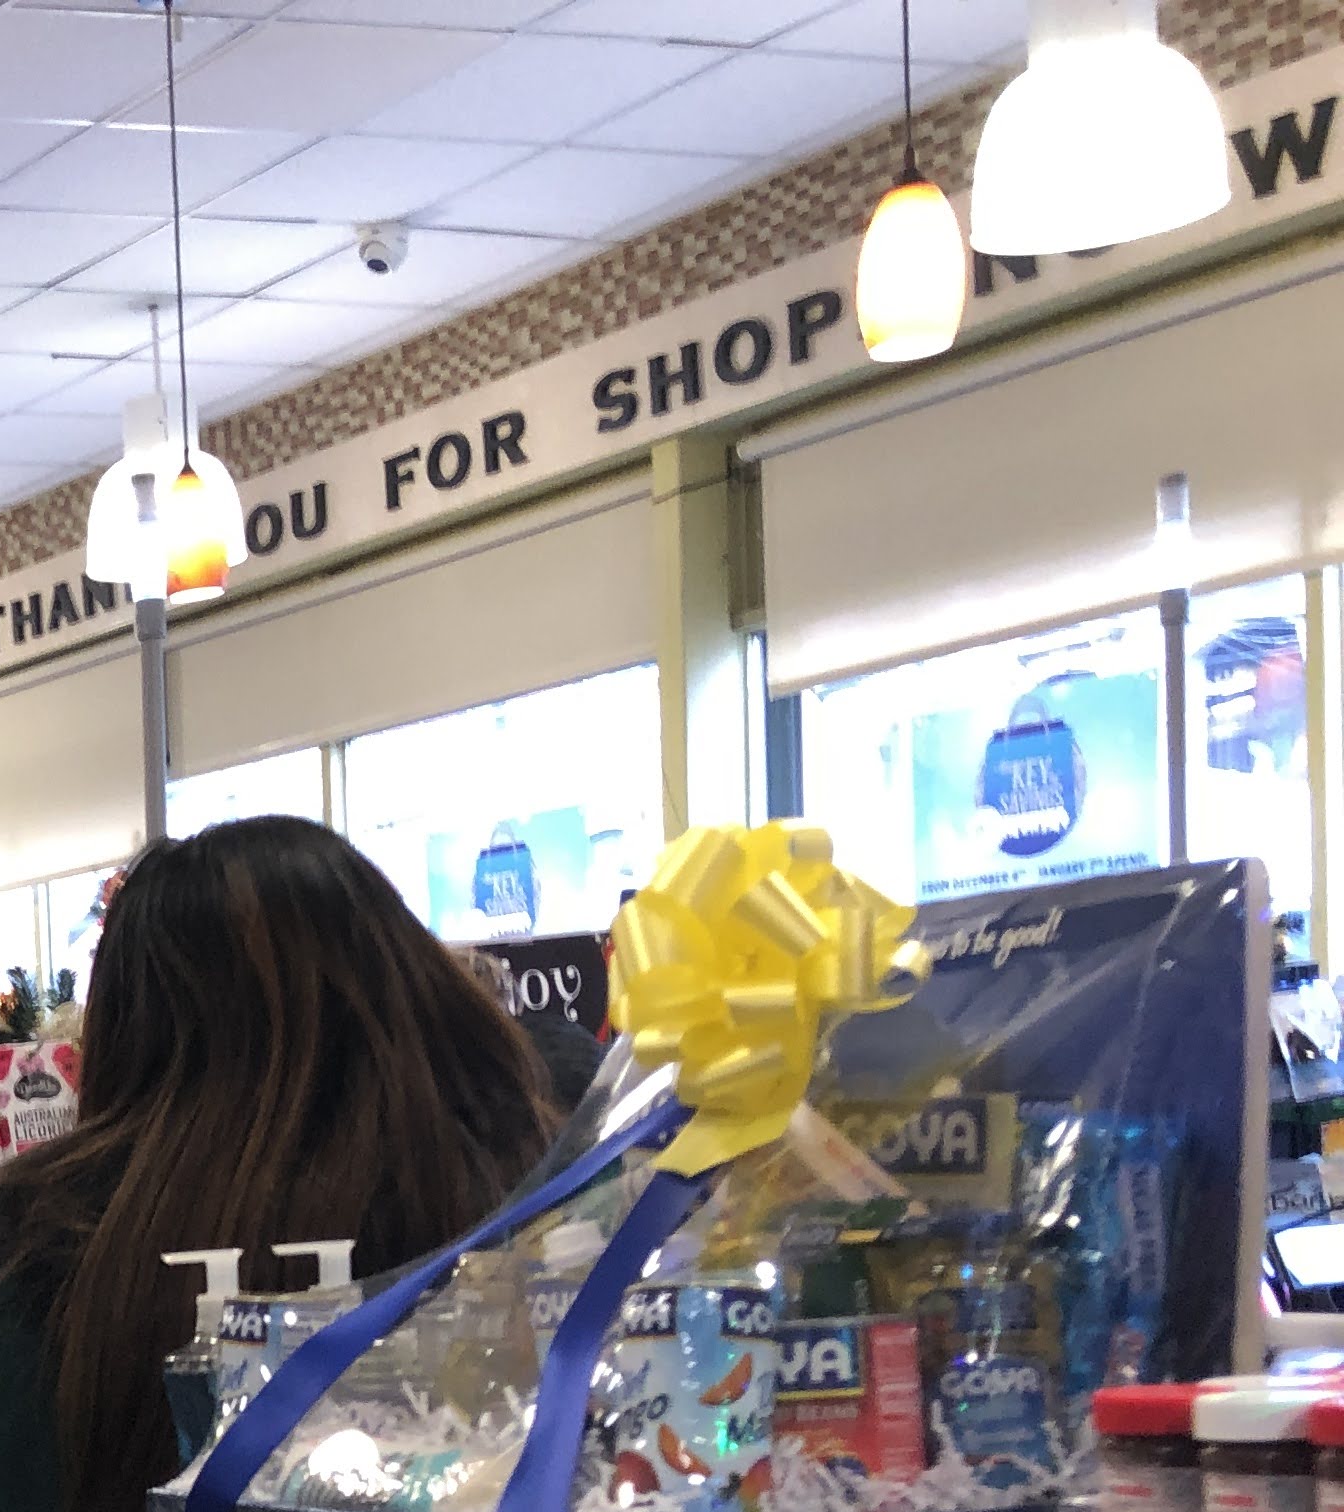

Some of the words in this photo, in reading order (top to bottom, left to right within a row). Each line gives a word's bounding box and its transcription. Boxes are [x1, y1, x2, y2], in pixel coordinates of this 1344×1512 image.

[245, 482, 328, 557] OU
[382, 409, 530, 512] FOR
[775, 1336, 854, 1386] YA
